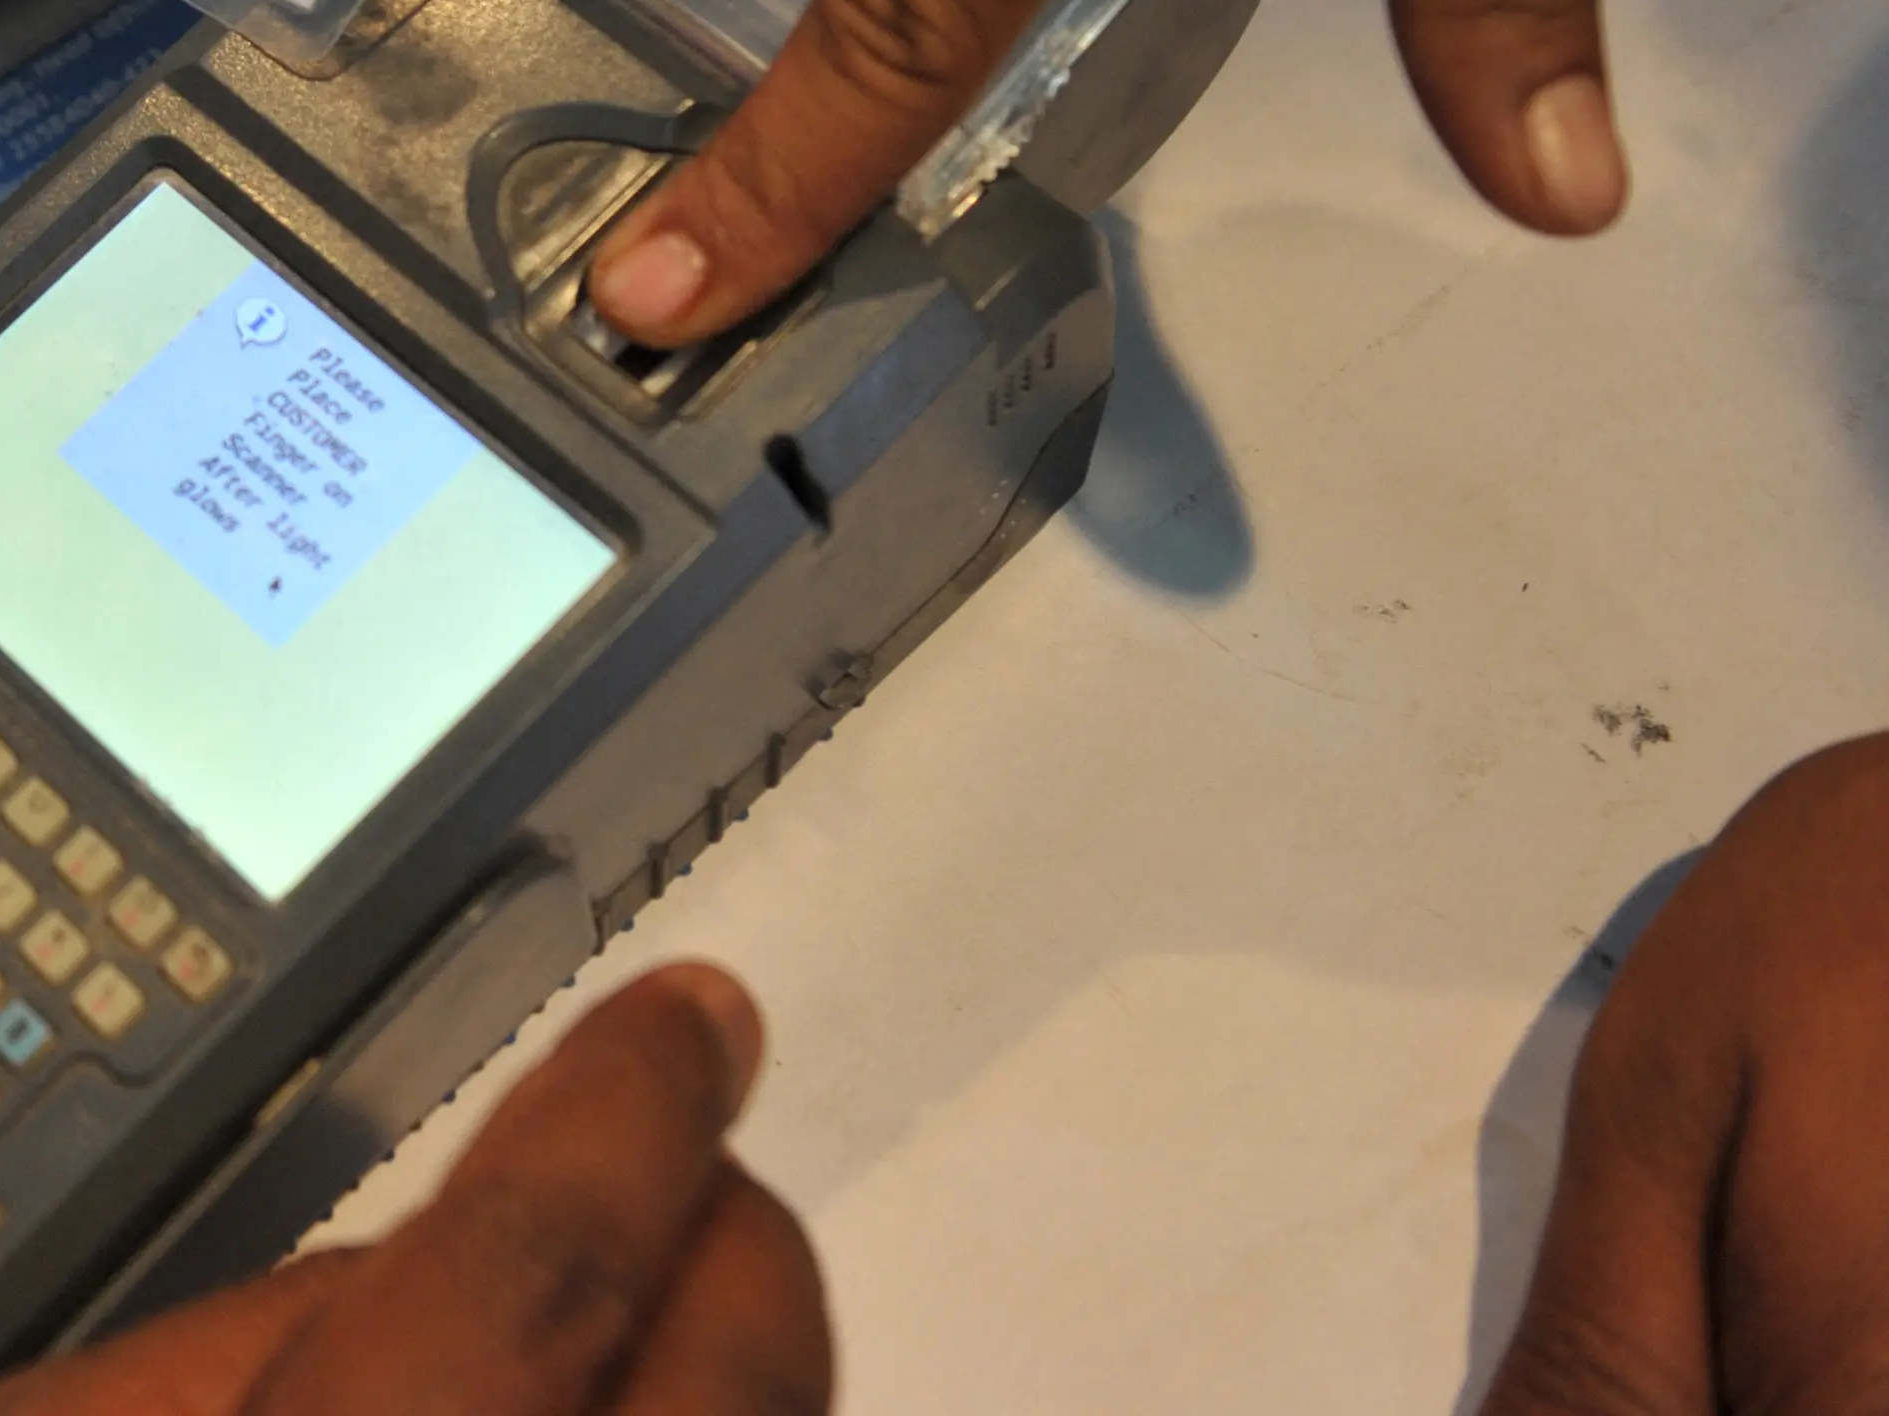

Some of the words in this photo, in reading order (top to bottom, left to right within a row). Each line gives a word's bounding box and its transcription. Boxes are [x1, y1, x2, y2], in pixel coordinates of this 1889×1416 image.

[287, 369, 352, 425] Place
[309, 347, 385, 413] Please
[222, 433, 308, 506] Scanner
[243, 411, 318, 474] Finger
[323, 481, 353, 508] on
[266, 390, 368, 477] CUSTOMER
[173, 478, 241, 534] glows
[198, 456, 264, 507] After
[266, 511, 332, 571] light
